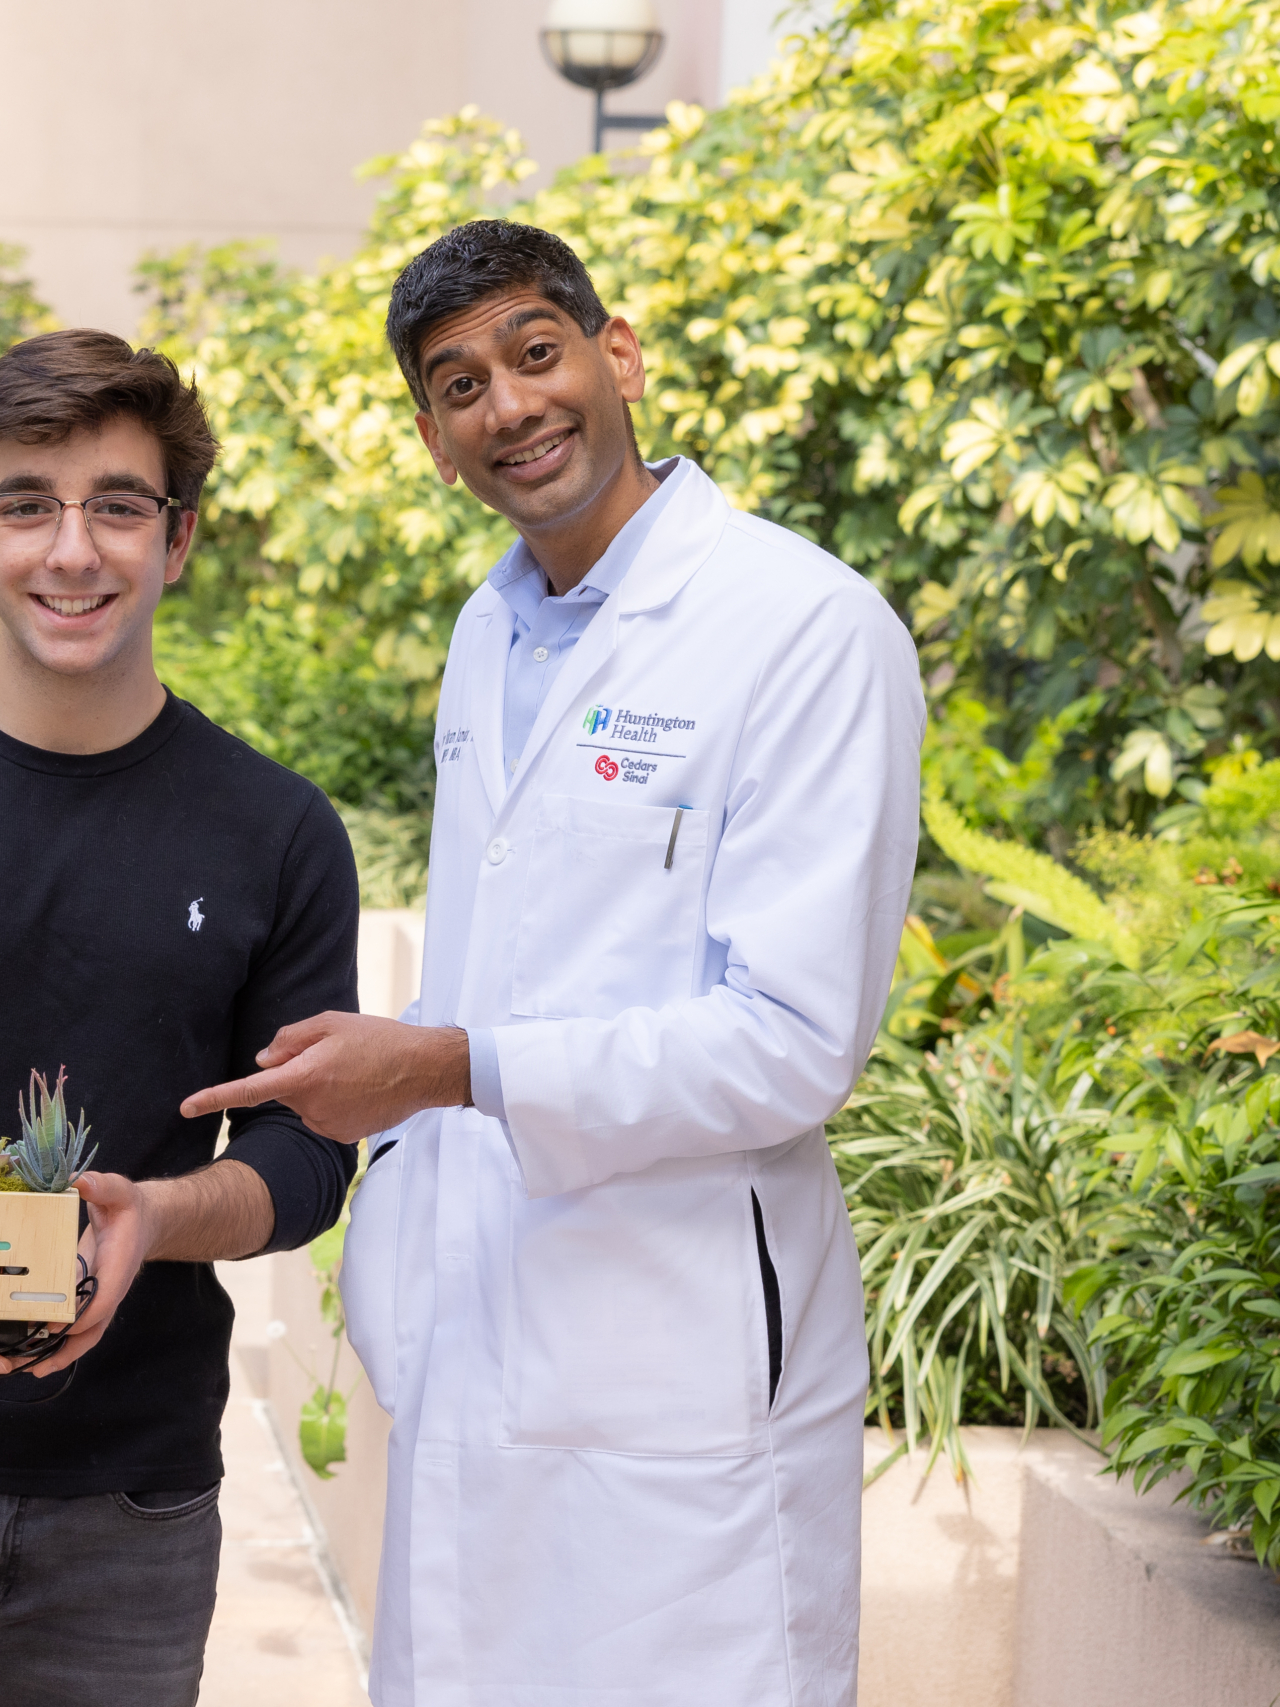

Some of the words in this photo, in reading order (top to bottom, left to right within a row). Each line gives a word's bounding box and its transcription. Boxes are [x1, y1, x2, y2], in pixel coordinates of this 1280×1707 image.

[615, 709, 696, 732] Huntington
[610, 724, 658, 743] Health
[620, 757, 658, 773] Cedars
[622, 770, 650, 785] Sinai
